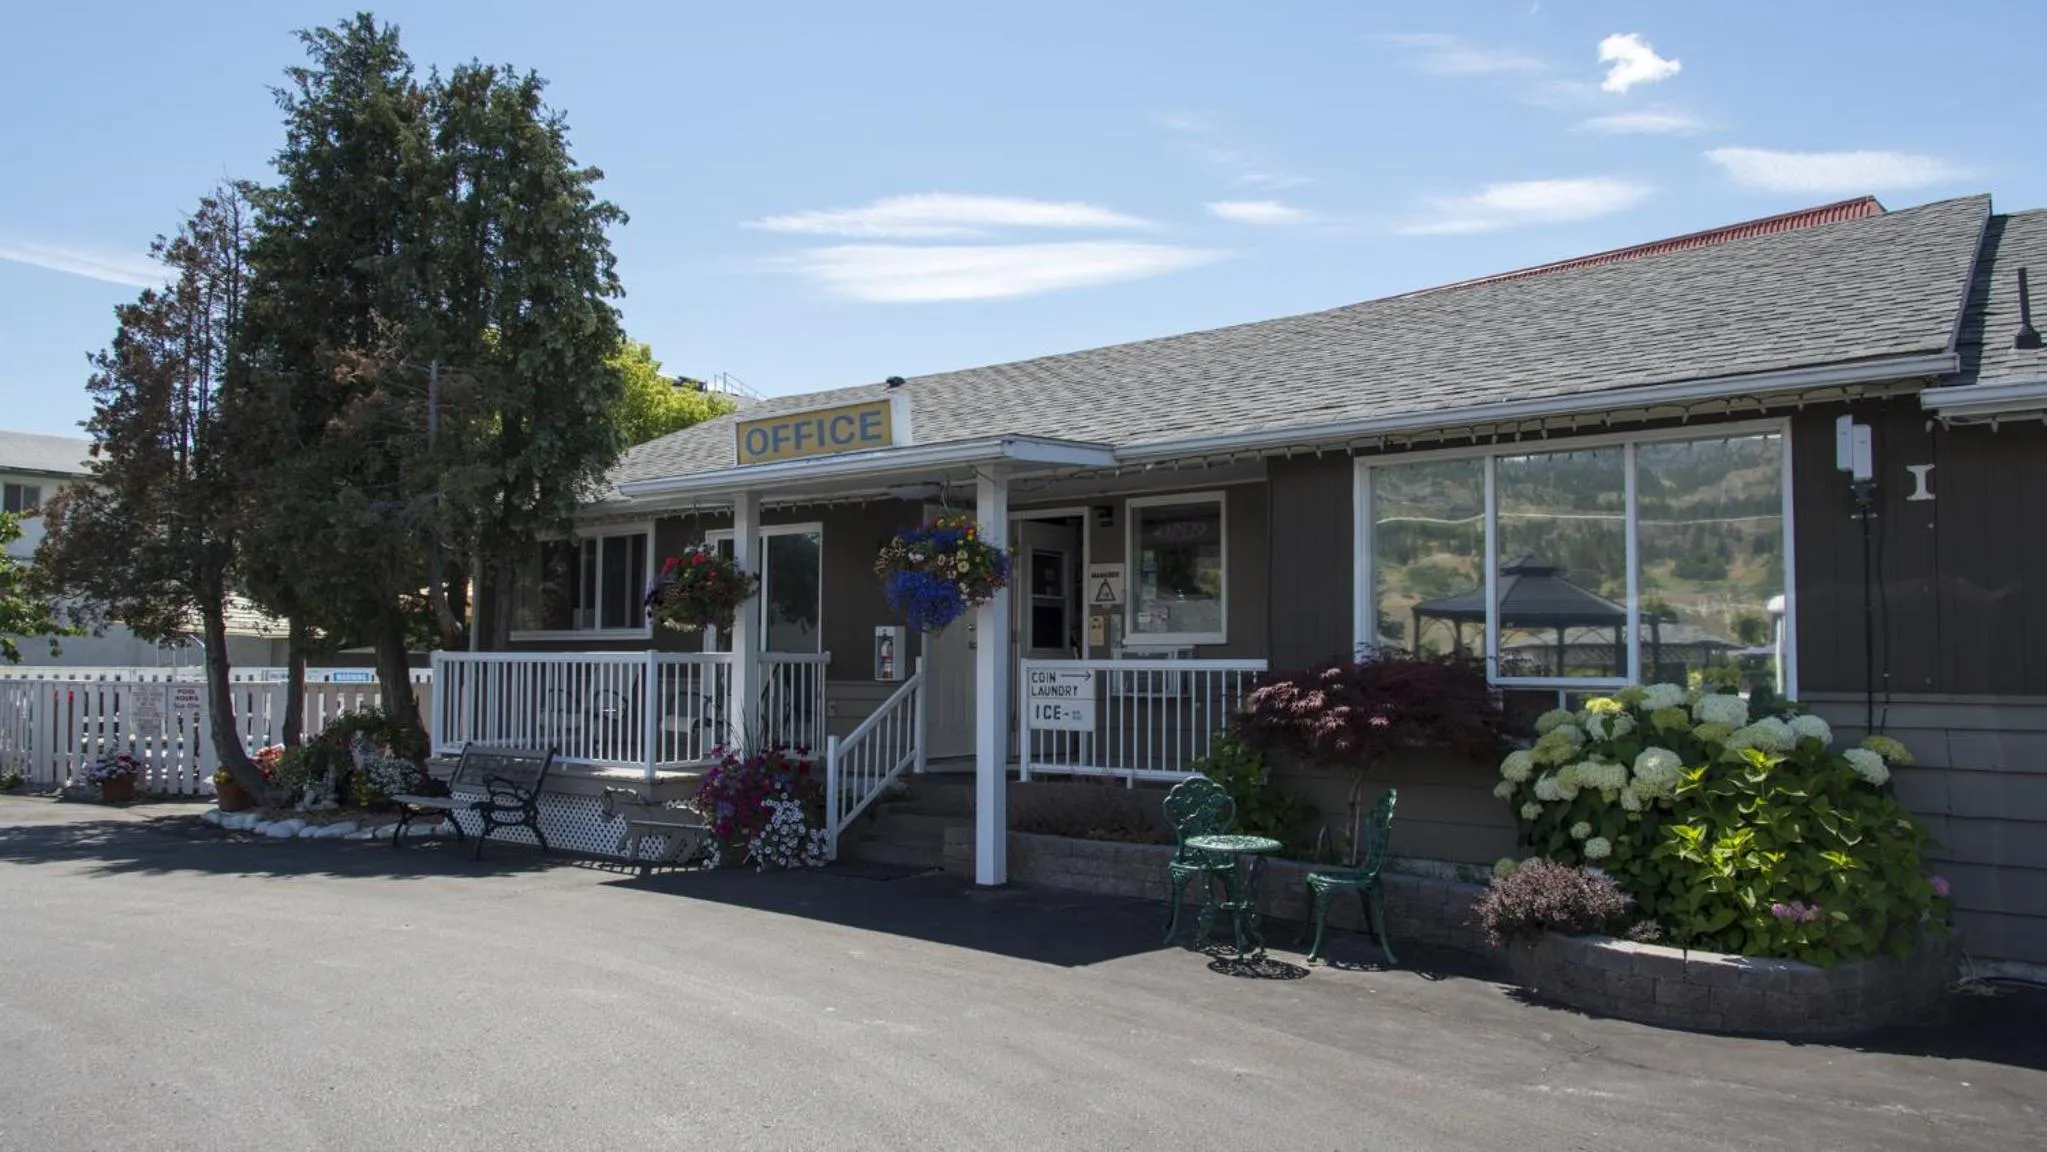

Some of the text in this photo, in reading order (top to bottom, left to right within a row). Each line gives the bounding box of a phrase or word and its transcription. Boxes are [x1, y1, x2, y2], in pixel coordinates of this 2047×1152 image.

[745, 409, 883, 457] OFFICE
[1031, 671, 1057, 684] COIN
[1031, 684, 1079, 697] LAUNDRY
